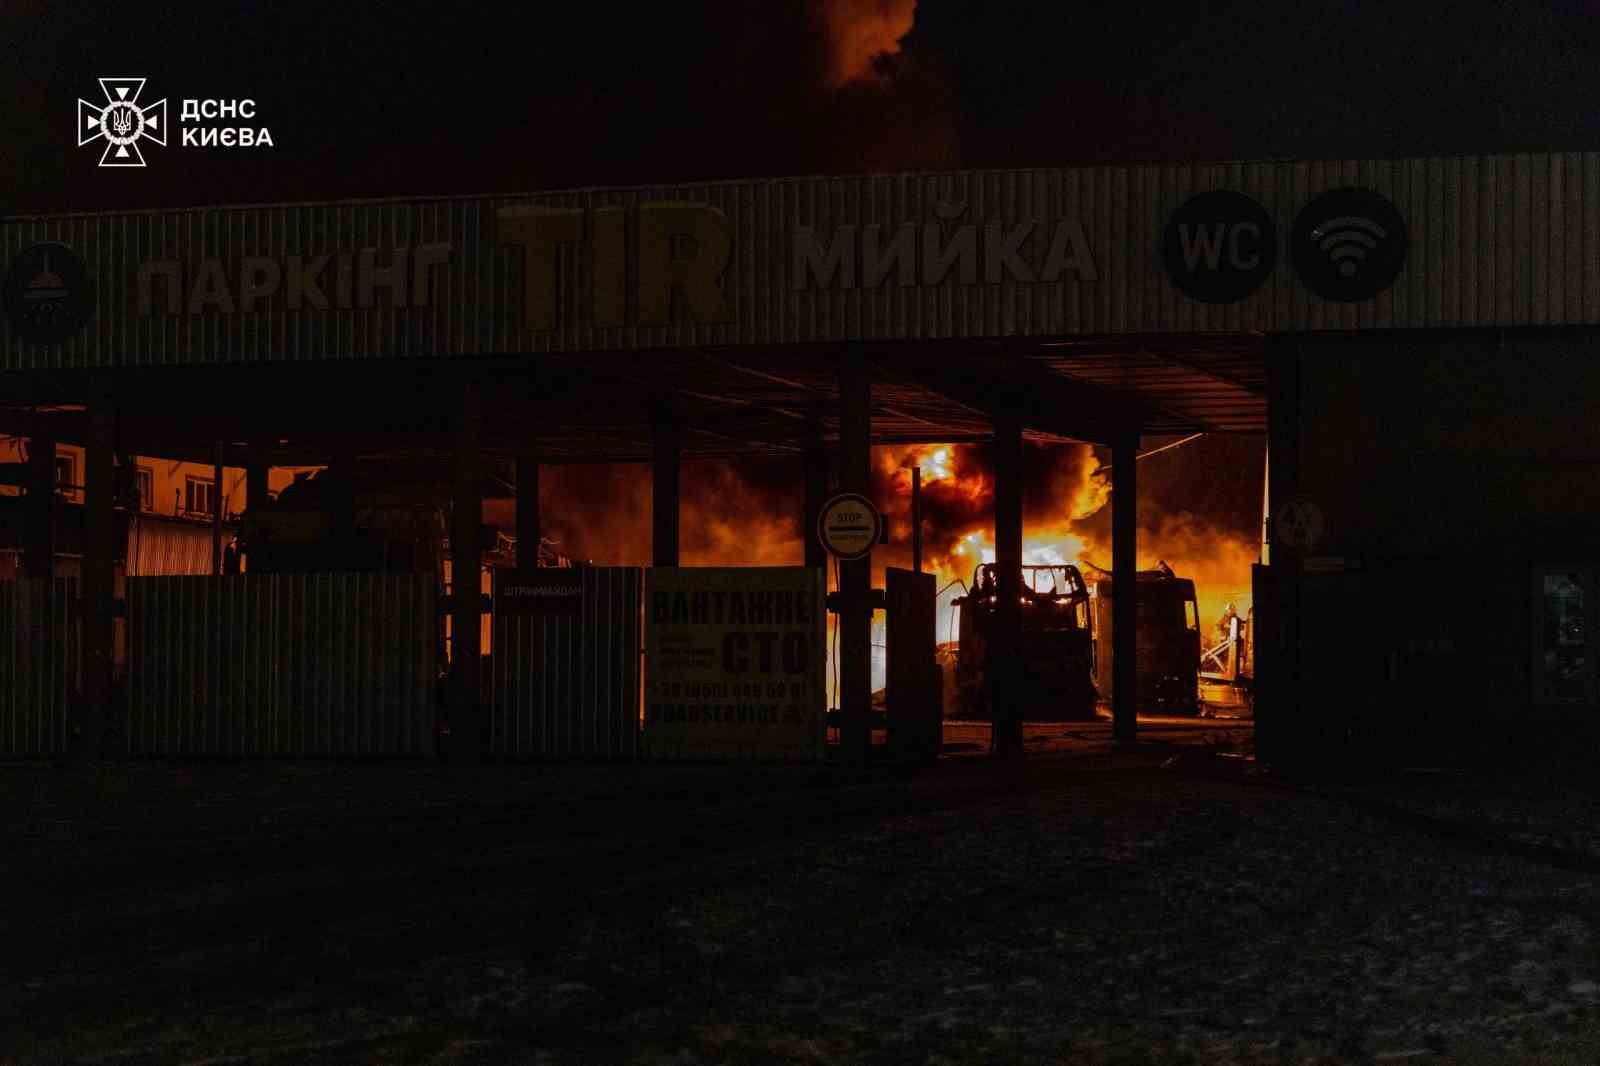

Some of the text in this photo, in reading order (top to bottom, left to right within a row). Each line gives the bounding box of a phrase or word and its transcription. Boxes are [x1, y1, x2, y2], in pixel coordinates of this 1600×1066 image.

[497, 201, 737, 332] TIR
[792, 200, 1099, 290] МИЙКА
[1178, 222, 1261, 272] WC
[136, 241, 454, 317] ПАРКІНГ
[838, 512, 863, 523] STOP
[653, 590, 810, 624] ВАНТАЖНЕ
[721, 631, 810, 674] СТО
